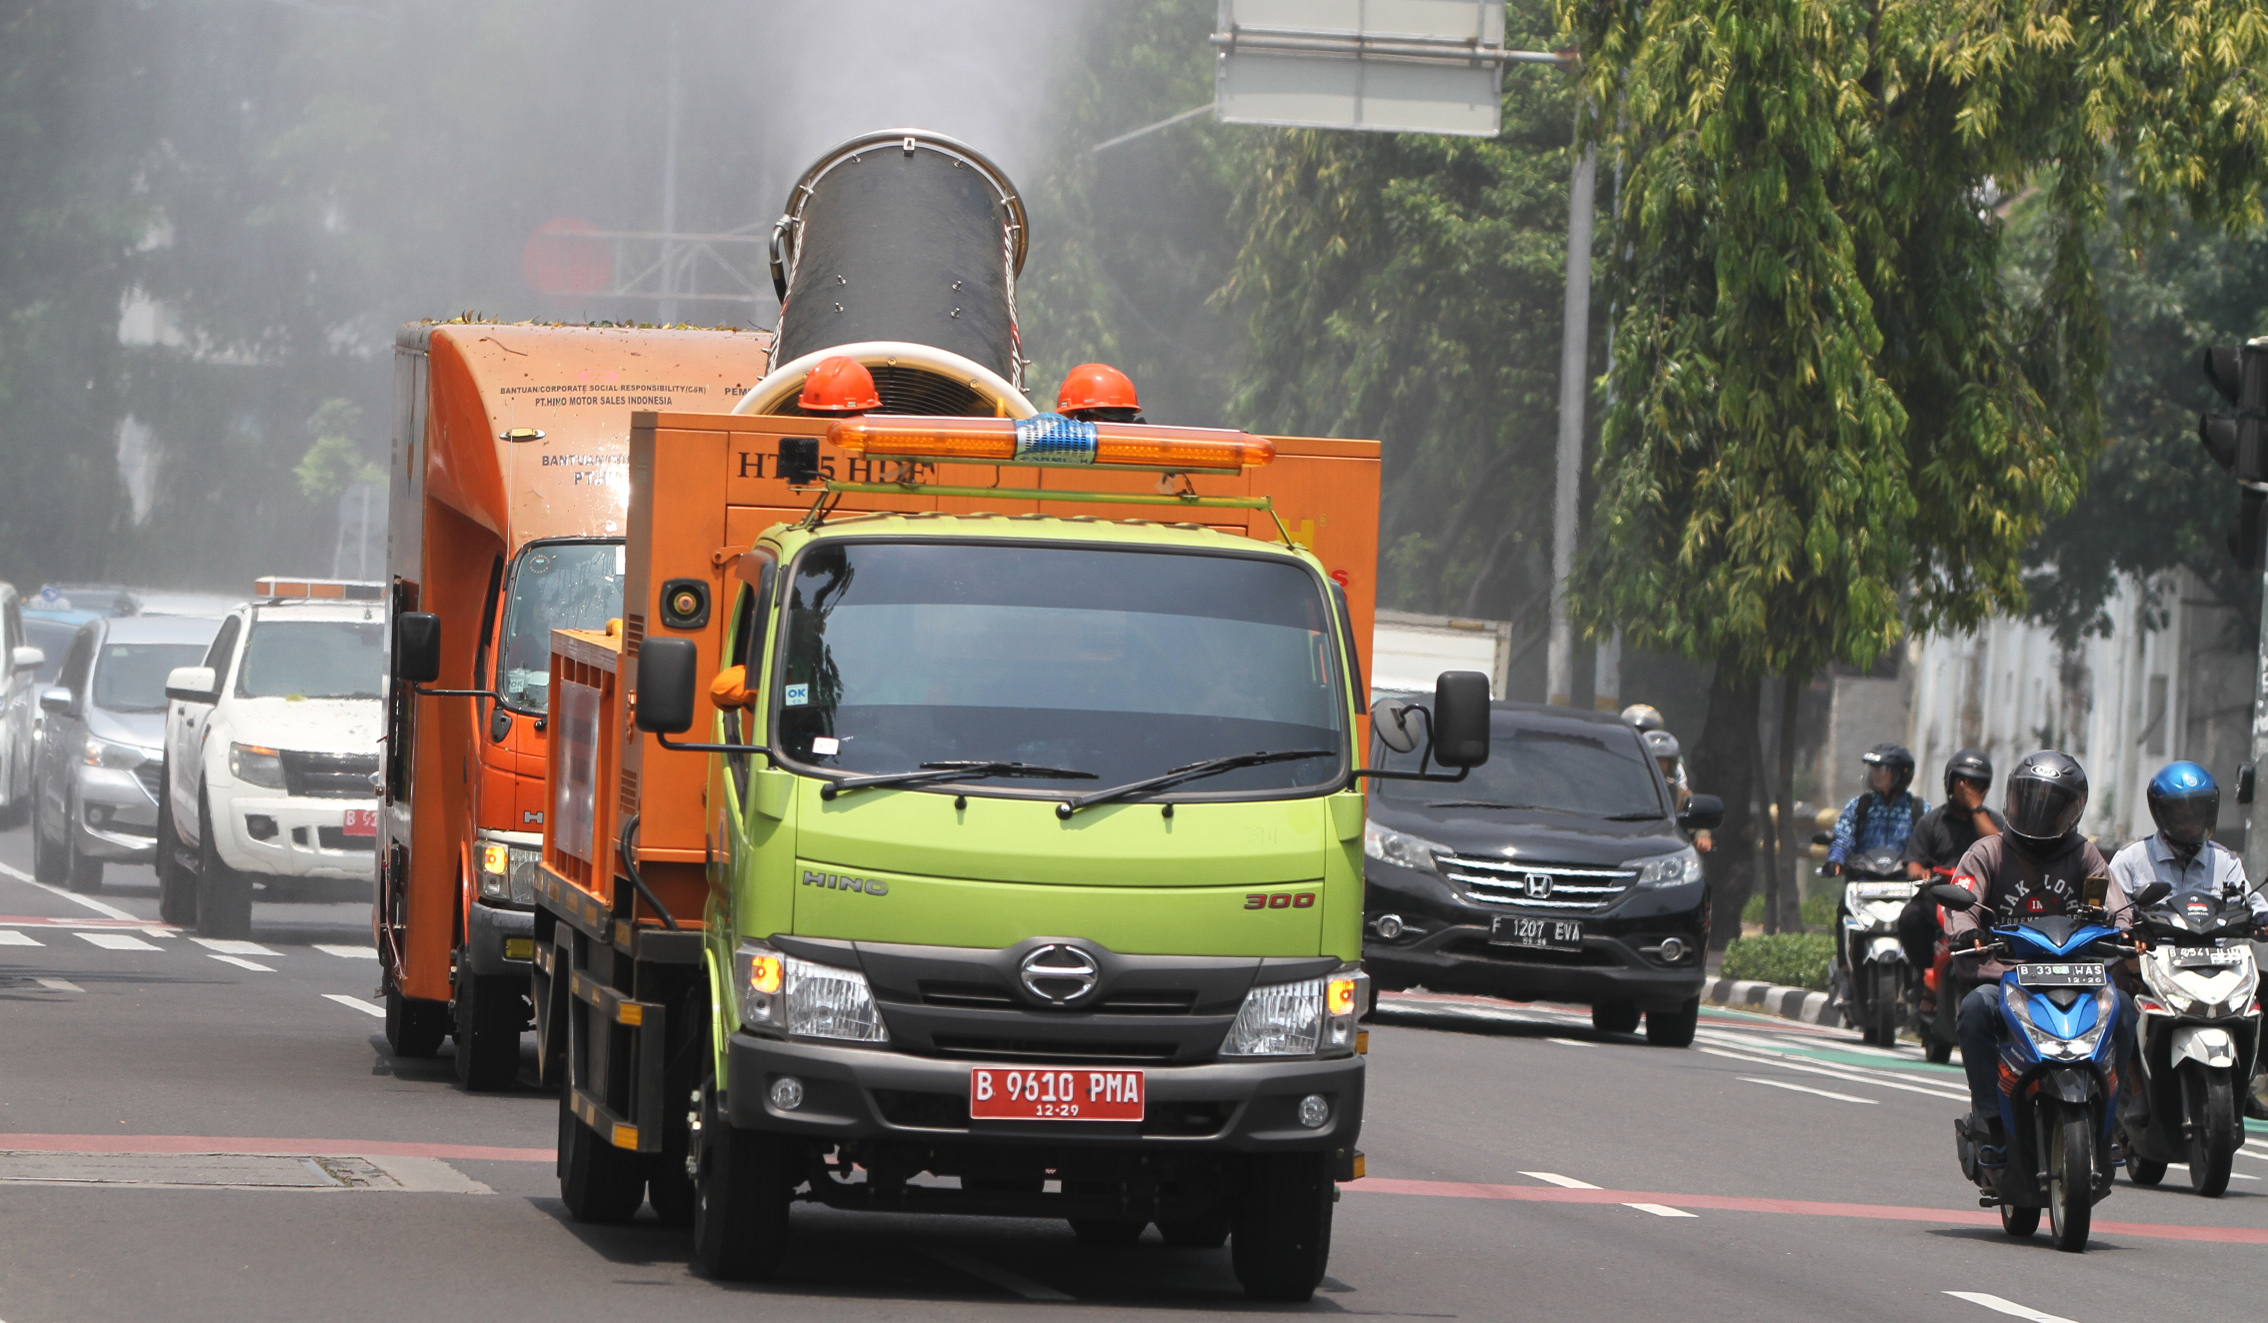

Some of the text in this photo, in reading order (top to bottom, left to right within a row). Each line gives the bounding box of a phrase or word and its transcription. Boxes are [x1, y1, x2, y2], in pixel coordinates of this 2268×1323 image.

[589, 384, 618, 393] SOCIAL
[535, 395, 672, 407] PT.HINO MOTOR SALES INDONESIA
[787, 688, 806, 698] OK
[346, 810, 356, 826] B
[803, 870, 889, 897] HINO
[1243, 892, 1317, 910] 300
[1491, 916, 1580, 942] F 1207 EVA
[2169, 948, 2176, 957] B
[2020, 966, 2029, 975] B
[2074, 965, 2102, 975] WAS
[976, 1071, 1139, 1103] B 9610 PMA
